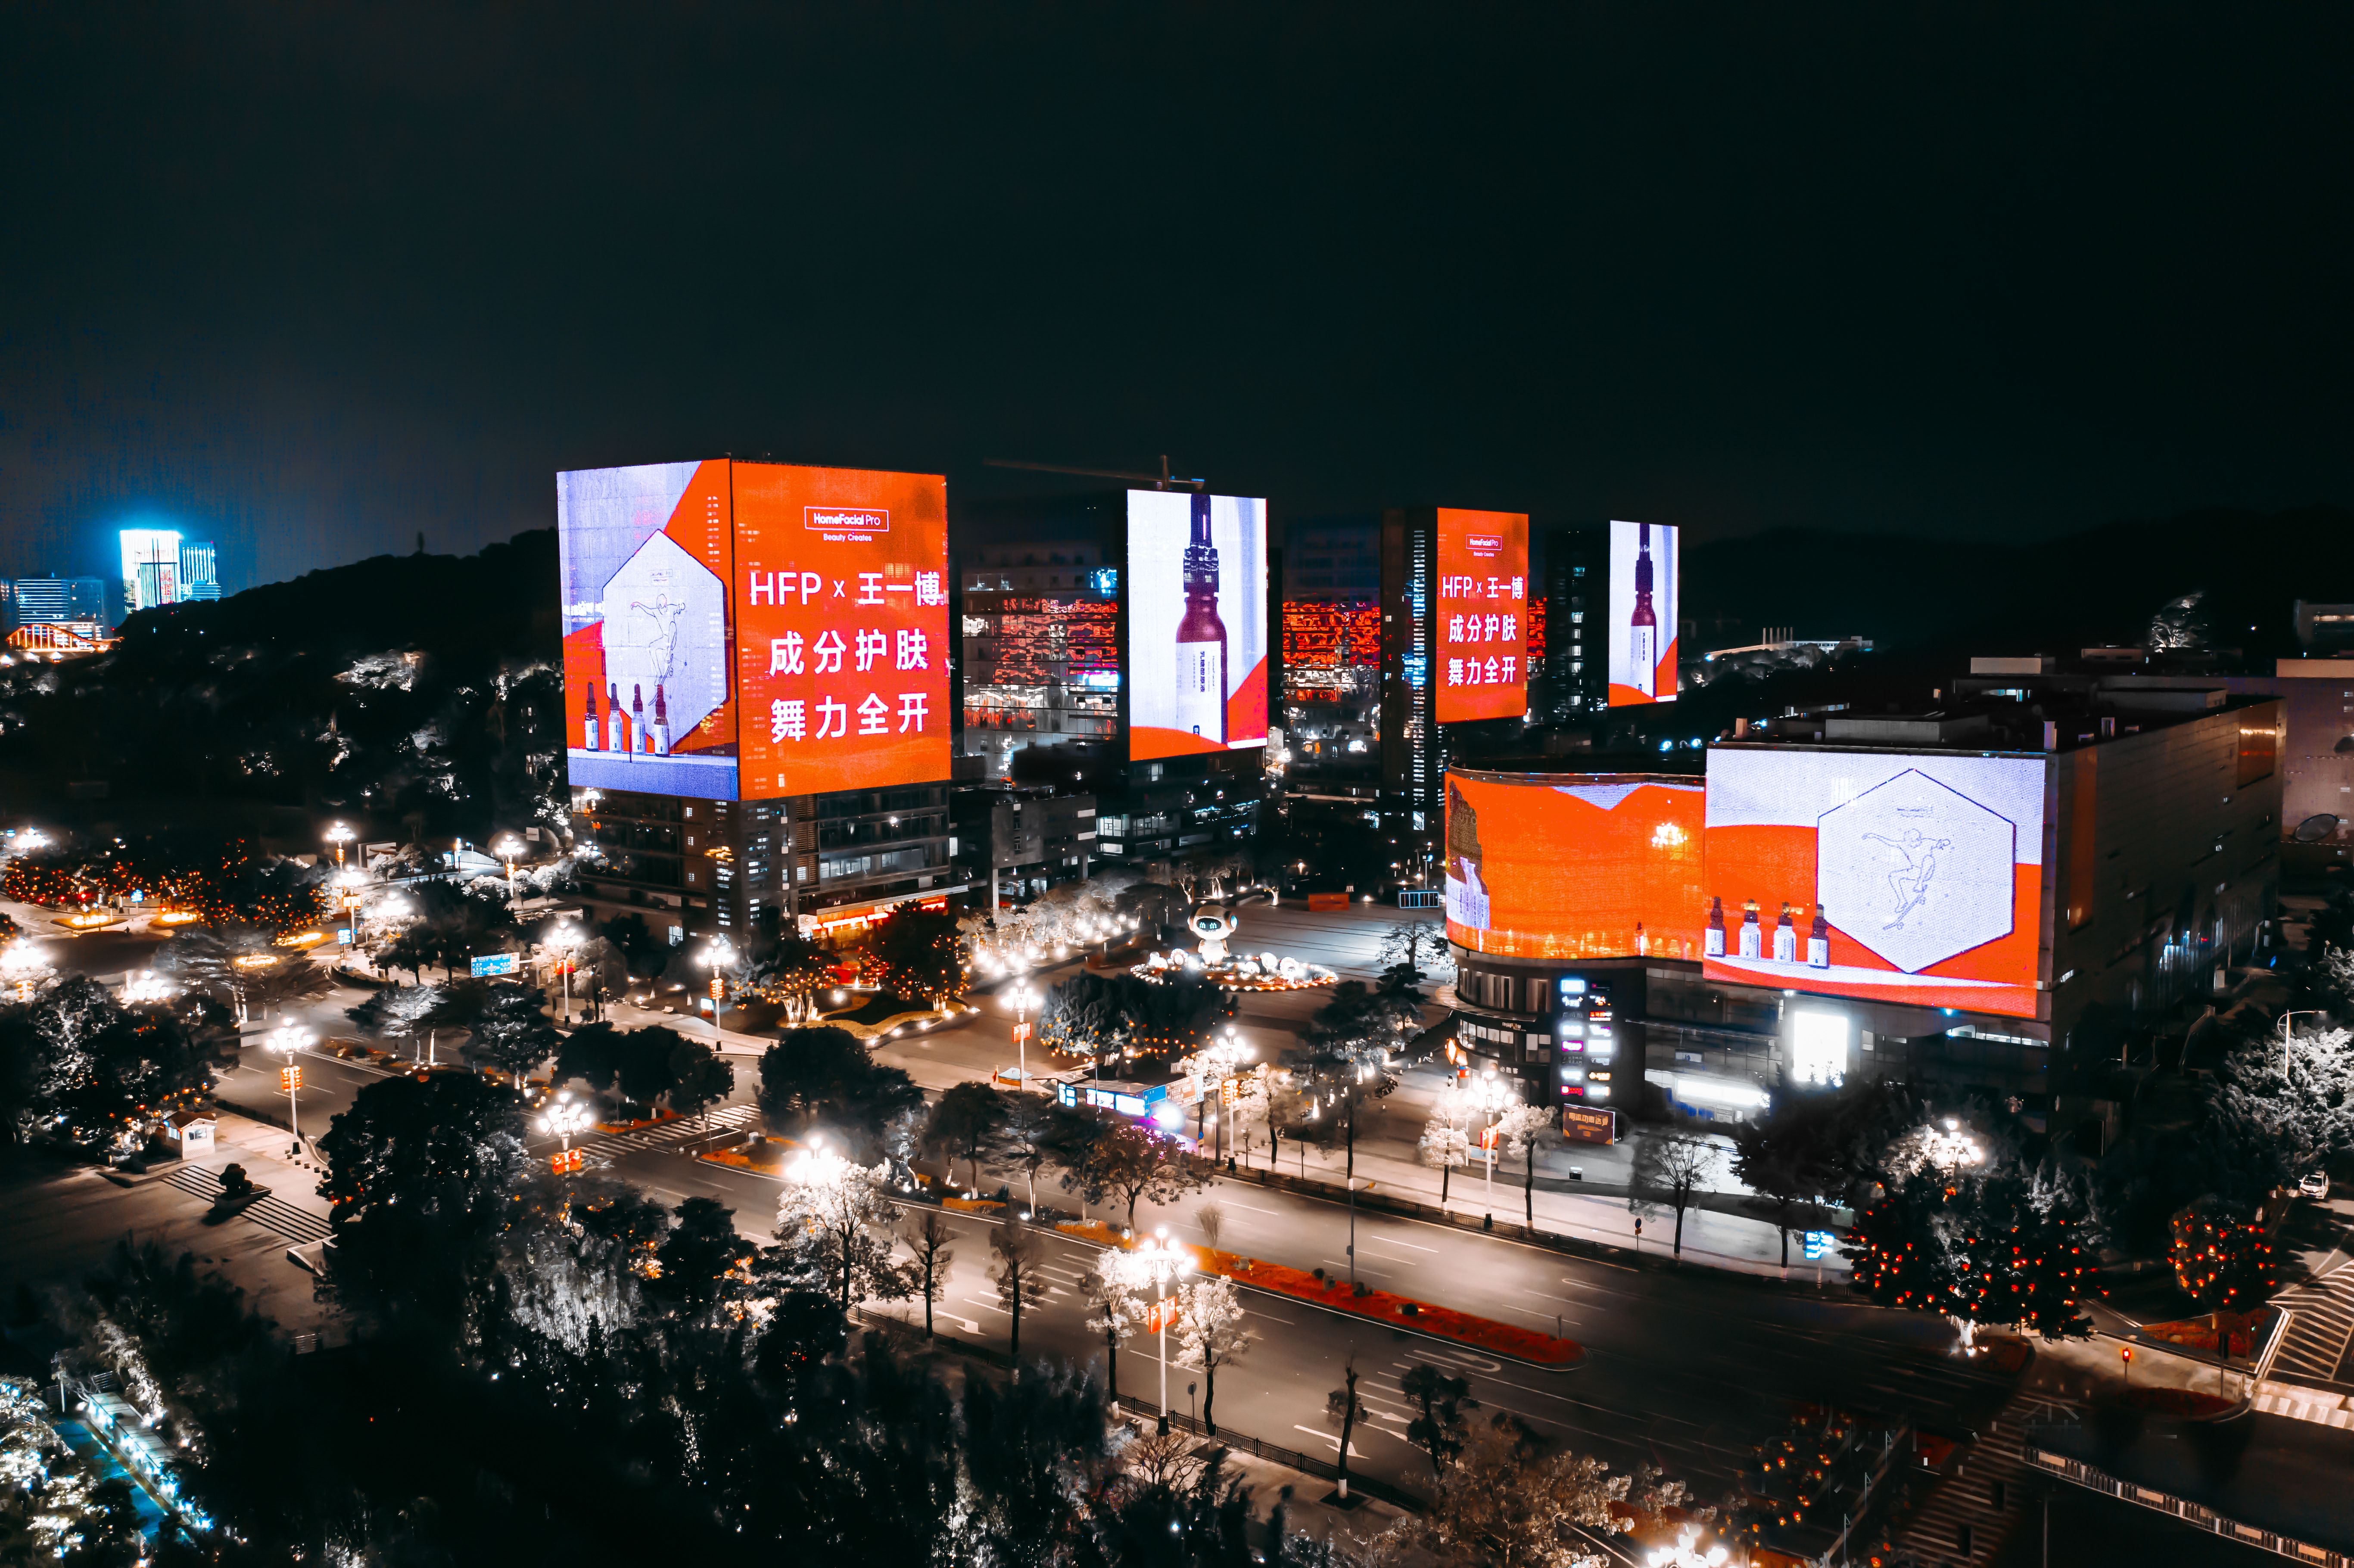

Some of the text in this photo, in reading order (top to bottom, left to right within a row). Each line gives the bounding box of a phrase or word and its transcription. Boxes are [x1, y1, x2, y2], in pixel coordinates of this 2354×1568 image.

[813, 513, 881, 526] HomeFacial Pro
[823, 533, 872, 542] Beauty Creates
[750, 572, 822, 606] HFP
[858, 571, 941, 606] 王一博
[1442, 576, 1473, 598] HFP
[1486, 576, 1523, 600] 王一博
[1448, 614, 1516, 643] 成分护肤
[769, 628, 928, 677] 成分护肤
[1448, 656, 1516, 687] 舞力全开
[771, 693, 929, 744] 舞力全开
[800, 915, 813, 925] BCS
